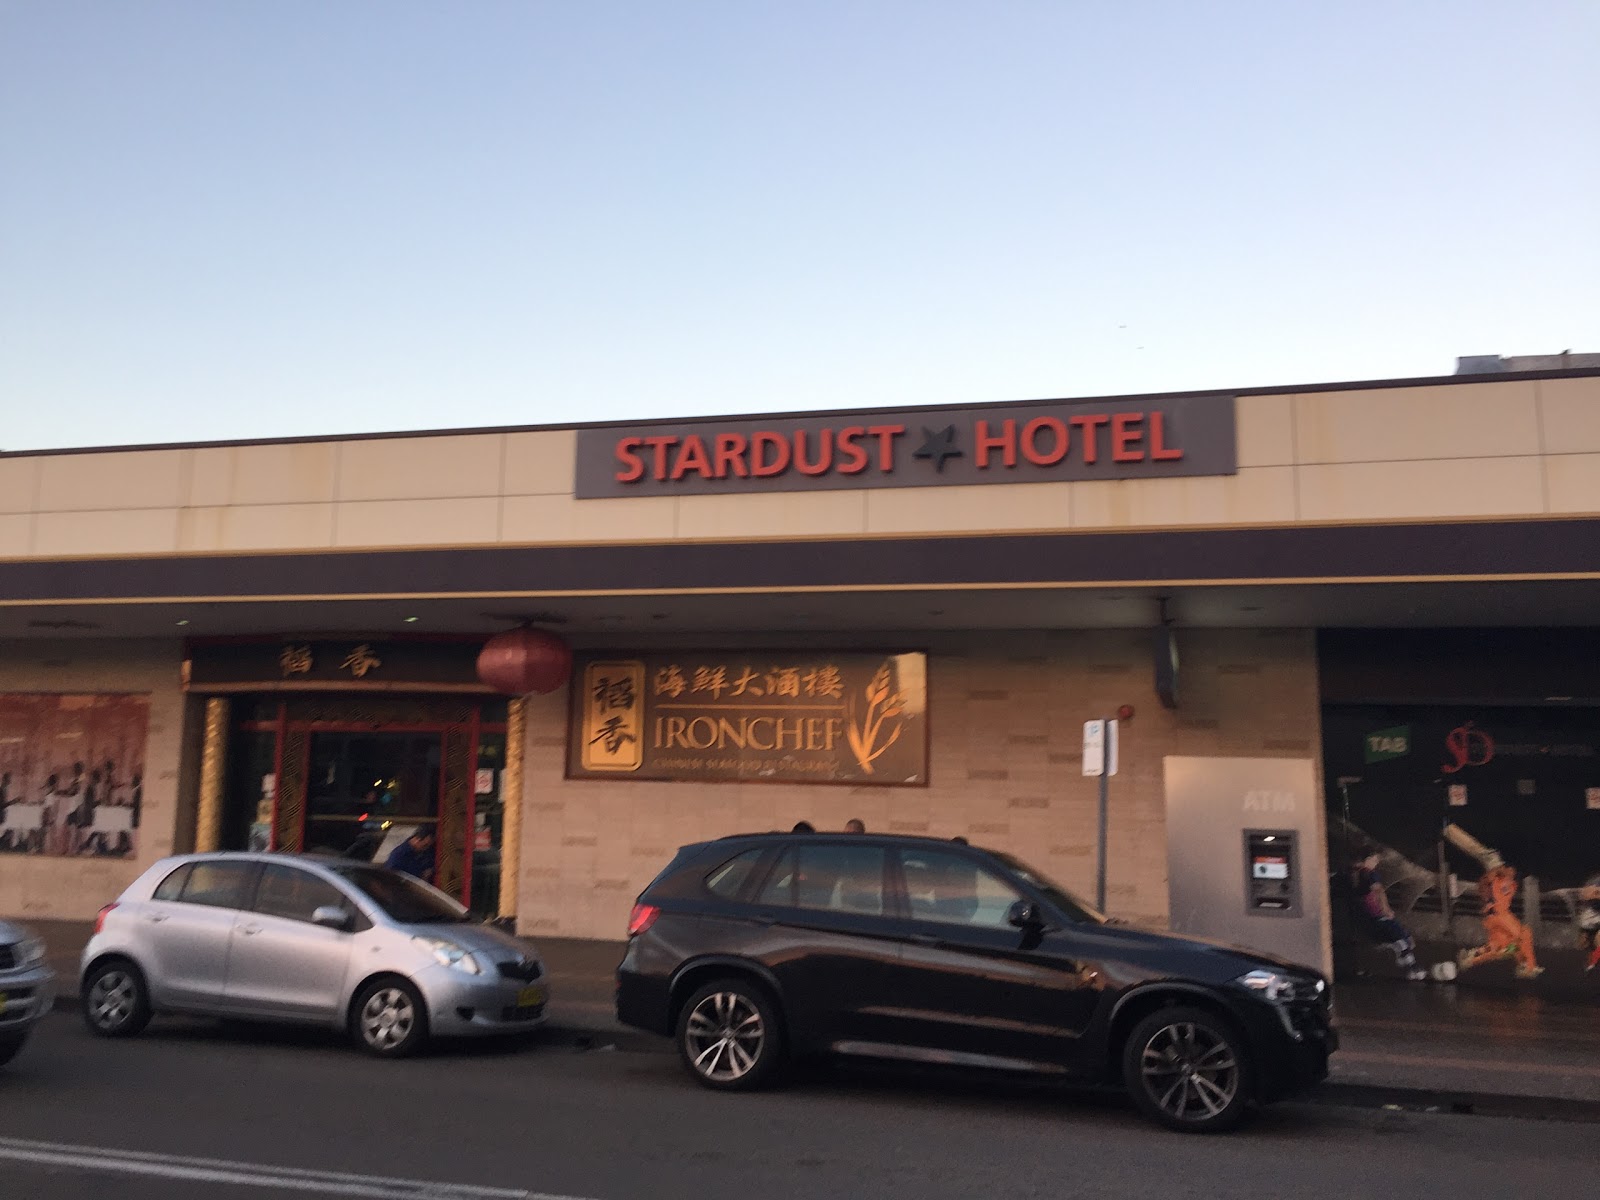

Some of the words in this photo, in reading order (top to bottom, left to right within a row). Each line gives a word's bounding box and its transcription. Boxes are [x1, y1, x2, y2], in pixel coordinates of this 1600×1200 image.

[614, 424, 906, 484] STARDUST
[974, 411, 1184, 469] HOTEL
[1366, 735, 1408, 753] TAB
[1243, 790, 1296, 813] ATM
